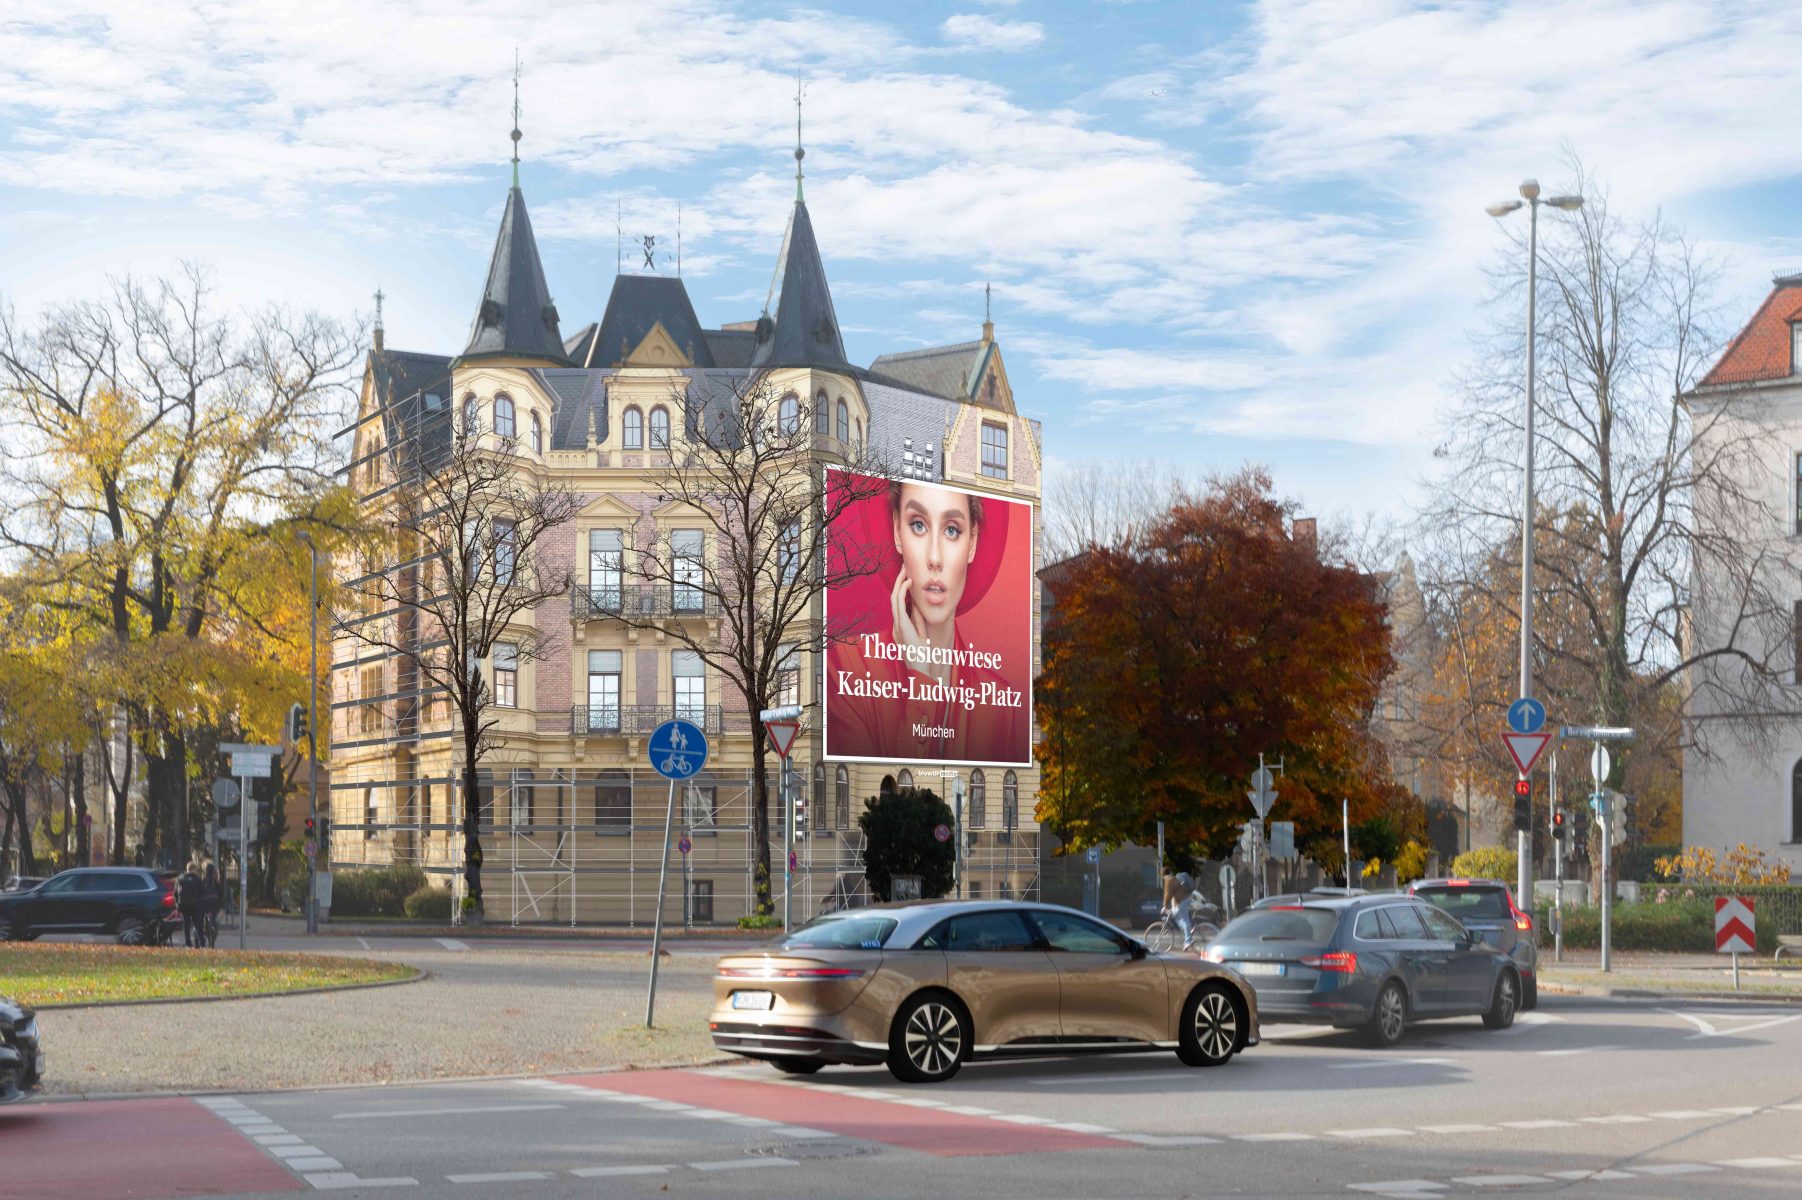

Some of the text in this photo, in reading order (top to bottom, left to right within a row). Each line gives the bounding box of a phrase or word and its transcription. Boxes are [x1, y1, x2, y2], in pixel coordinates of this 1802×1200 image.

[860, 633, 1002, 670] Theresienwiese
[837, 670, 1022, 710] Kaiser-Ludwig-Platz
[912, 723, 955, 739] München
